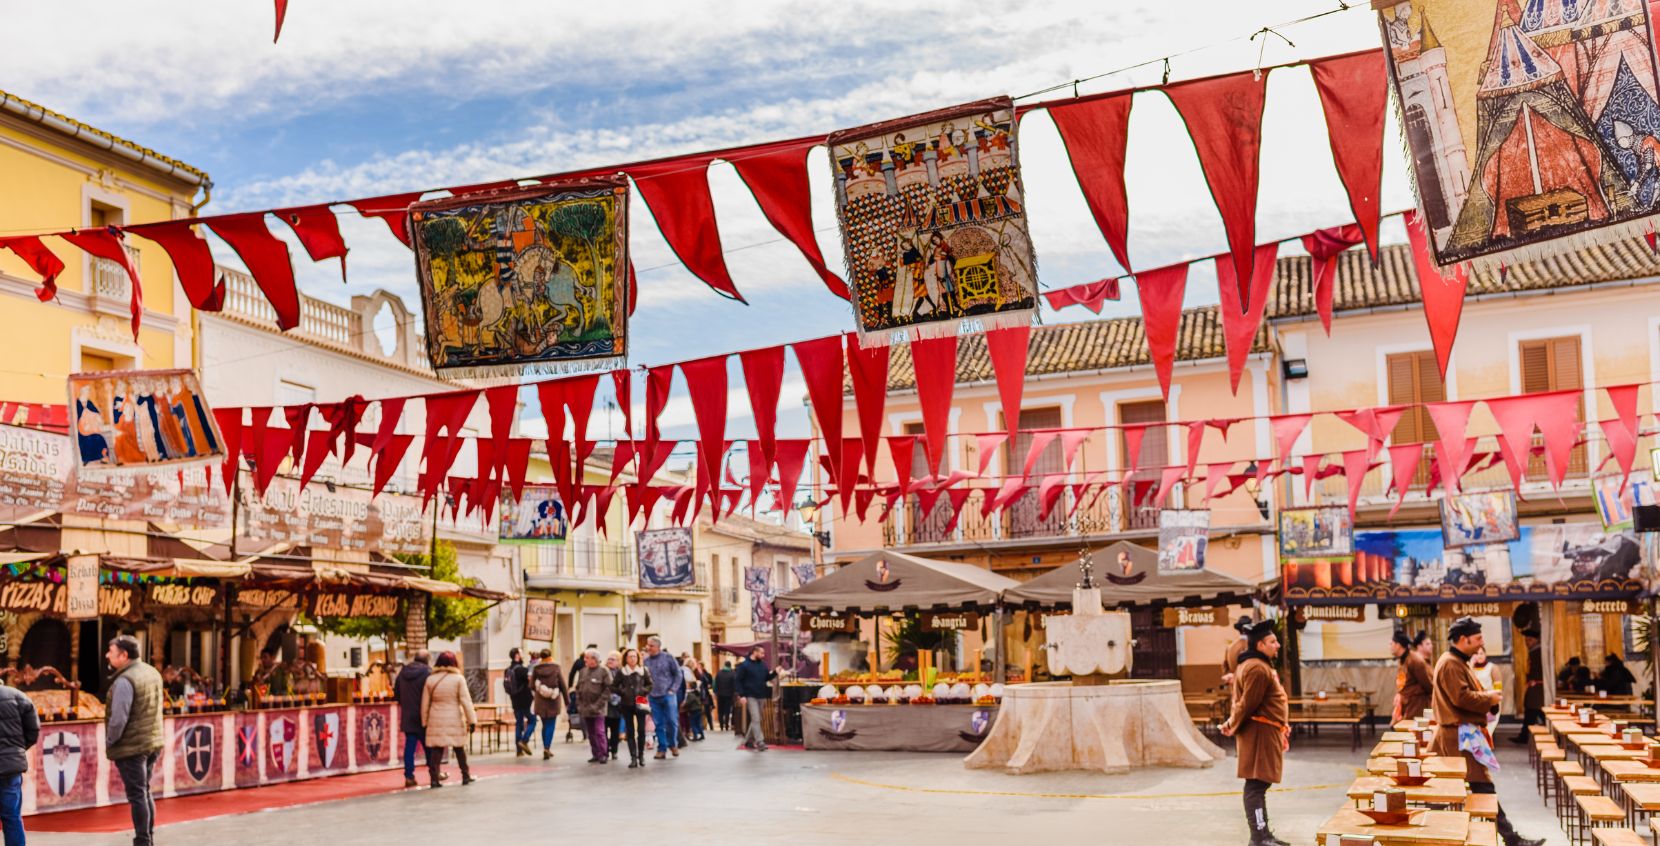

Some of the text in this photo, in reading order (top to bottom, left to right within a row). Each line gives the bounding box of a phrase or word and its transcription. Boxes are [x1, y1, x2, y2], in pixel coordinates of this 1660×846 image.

[301, 486, 368, 519] Artesanos
[1302, 605, 1359, 619] Puntillitas
[1452, 602, 1500, 616] Chorizos
[1583, 599, 1628, 613] Secreto
[809, 615, 846, 629] Chorizos
[1177, 608, 1215, 624] Bravas
